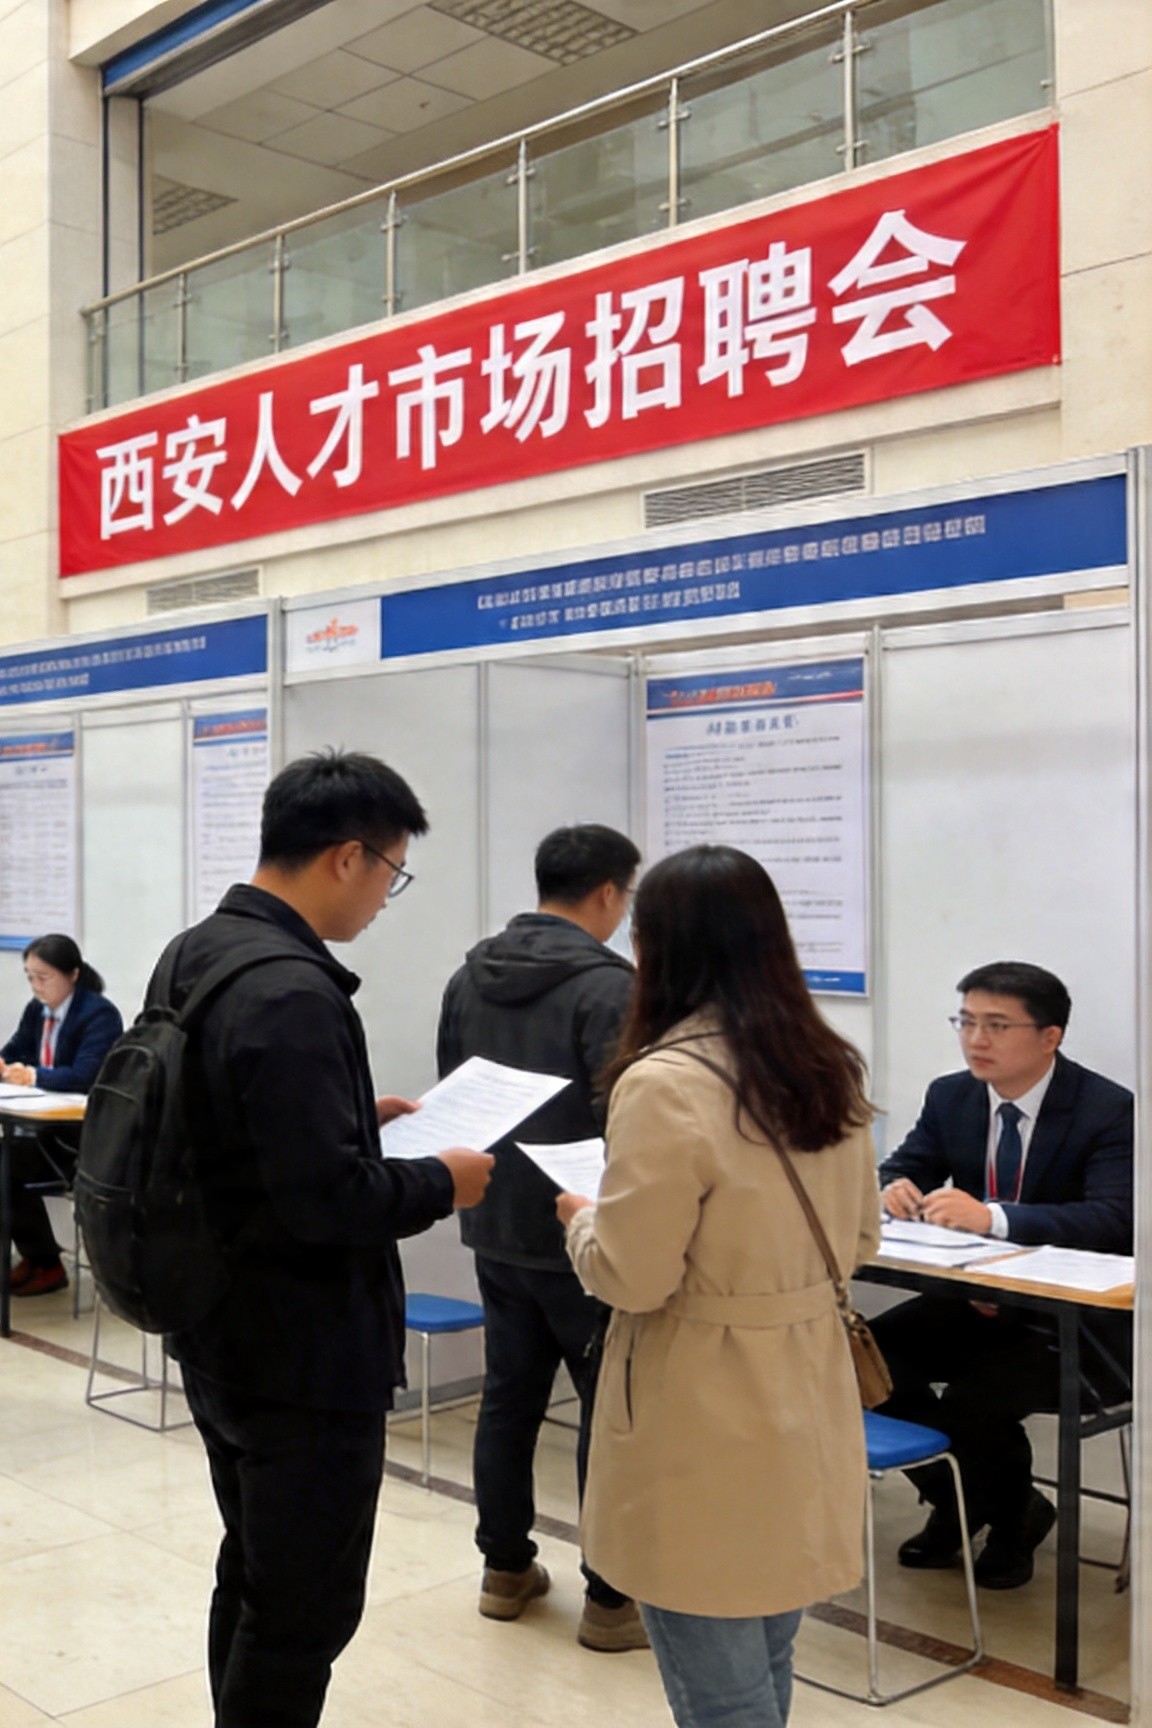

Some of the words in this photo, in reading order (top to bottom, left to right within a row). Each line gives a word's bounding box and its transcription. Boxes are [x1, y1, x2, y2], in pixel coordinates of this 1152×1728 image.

[96, 208, 967, 541] 西安人才市场招聘会
